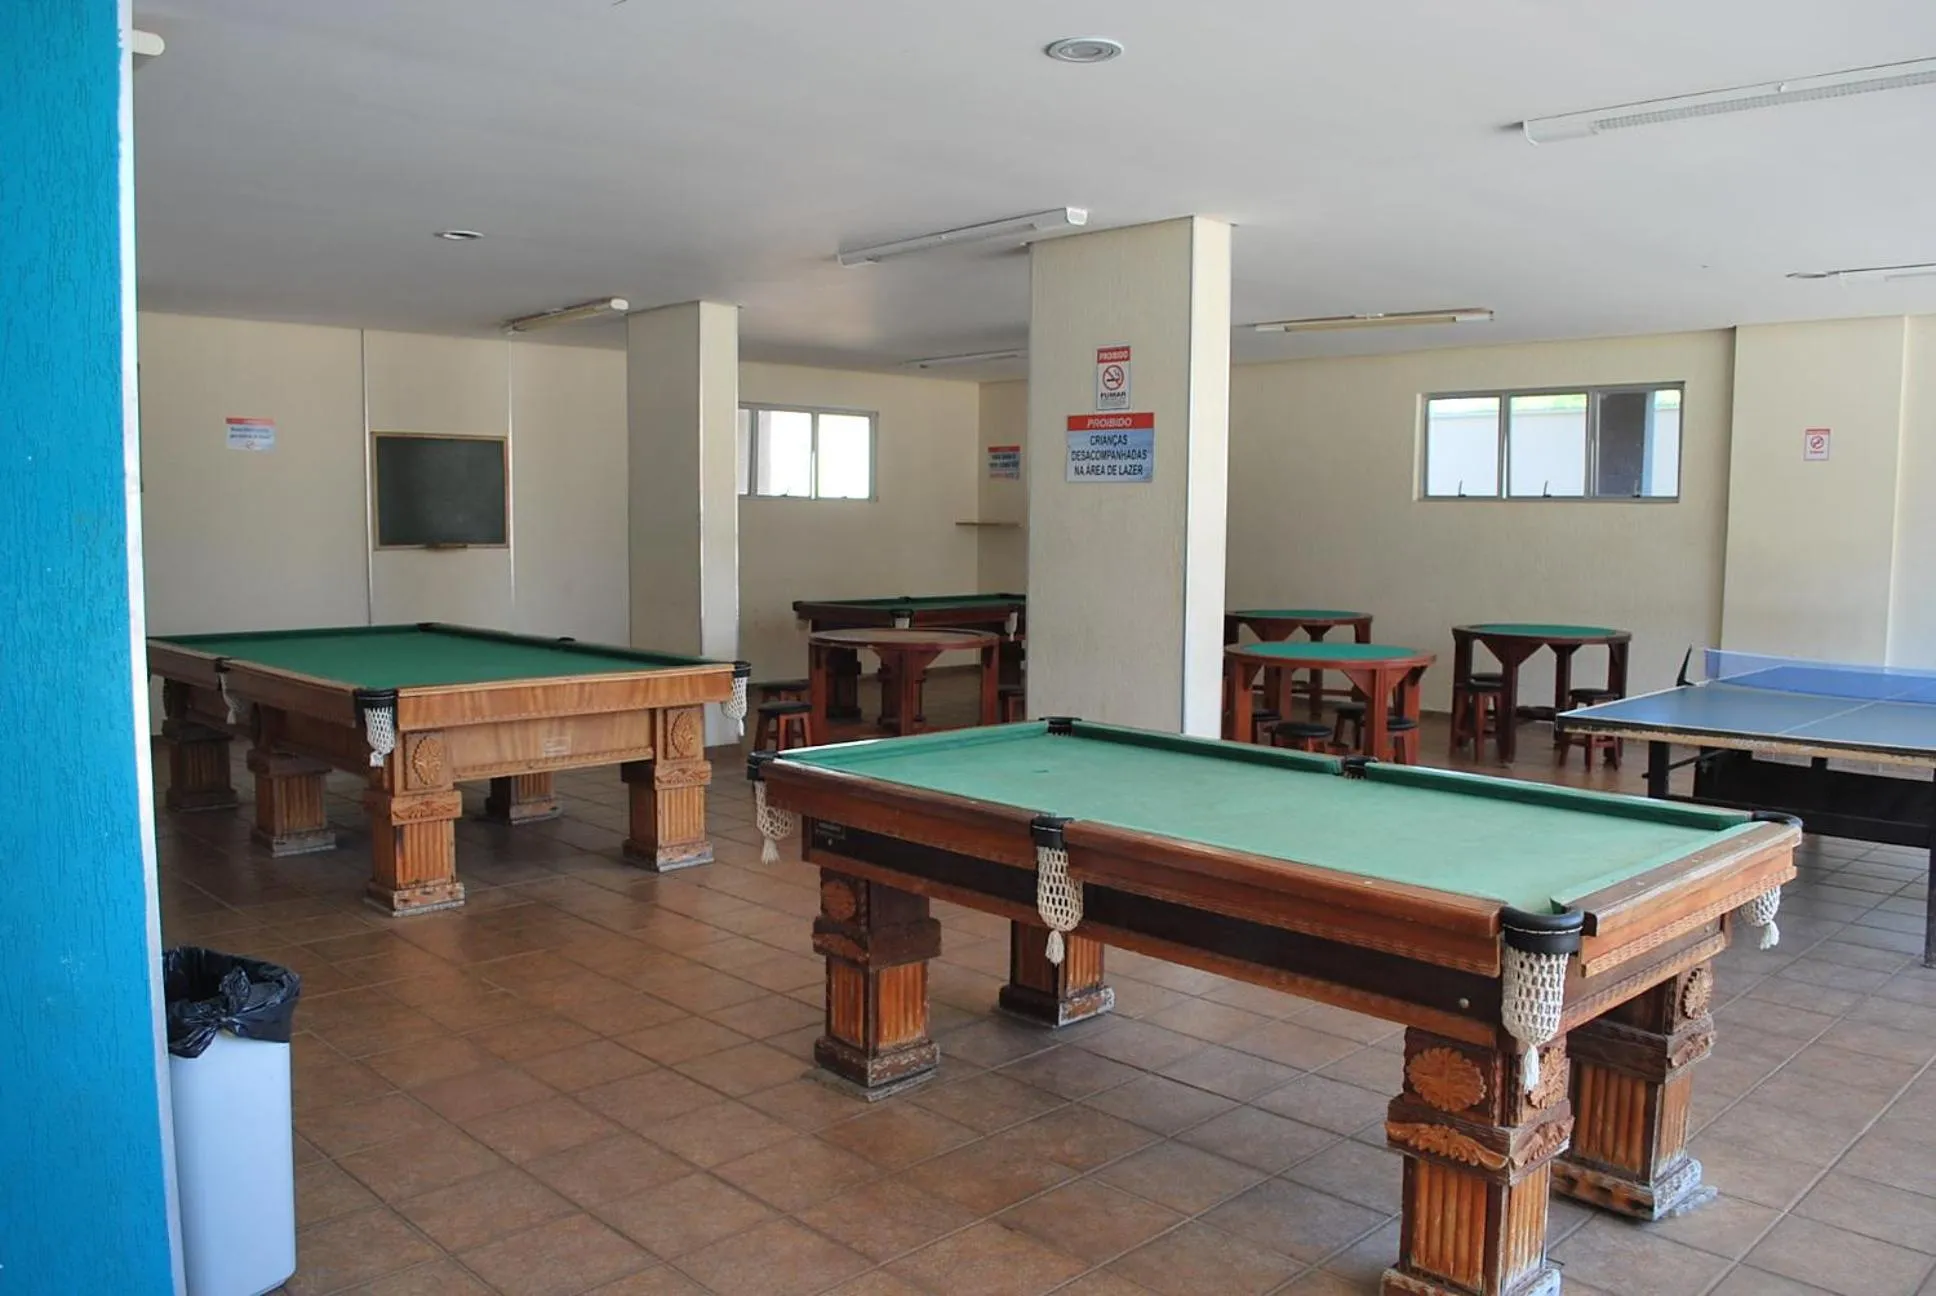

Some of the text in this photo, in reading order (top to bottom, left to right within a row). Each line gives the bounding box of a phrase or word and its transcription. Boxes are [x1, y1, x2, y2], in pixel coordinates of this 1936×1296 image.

[1099, 350, 1129, 361] PROIBIDO
[1100, 391, 1127, 400] FUMAR
[1087, 417, 1133, 428] PROIBIDO
[1090, 434, 1128, 446] CRIANÇAS
[1071, 449, 1148, 461] DESACOMPANHADAS
[1074, 465, 1084, 476] NA
[1107, 465, 1117, 476] DE
[1119, 464, 1143, 476] LAZER
